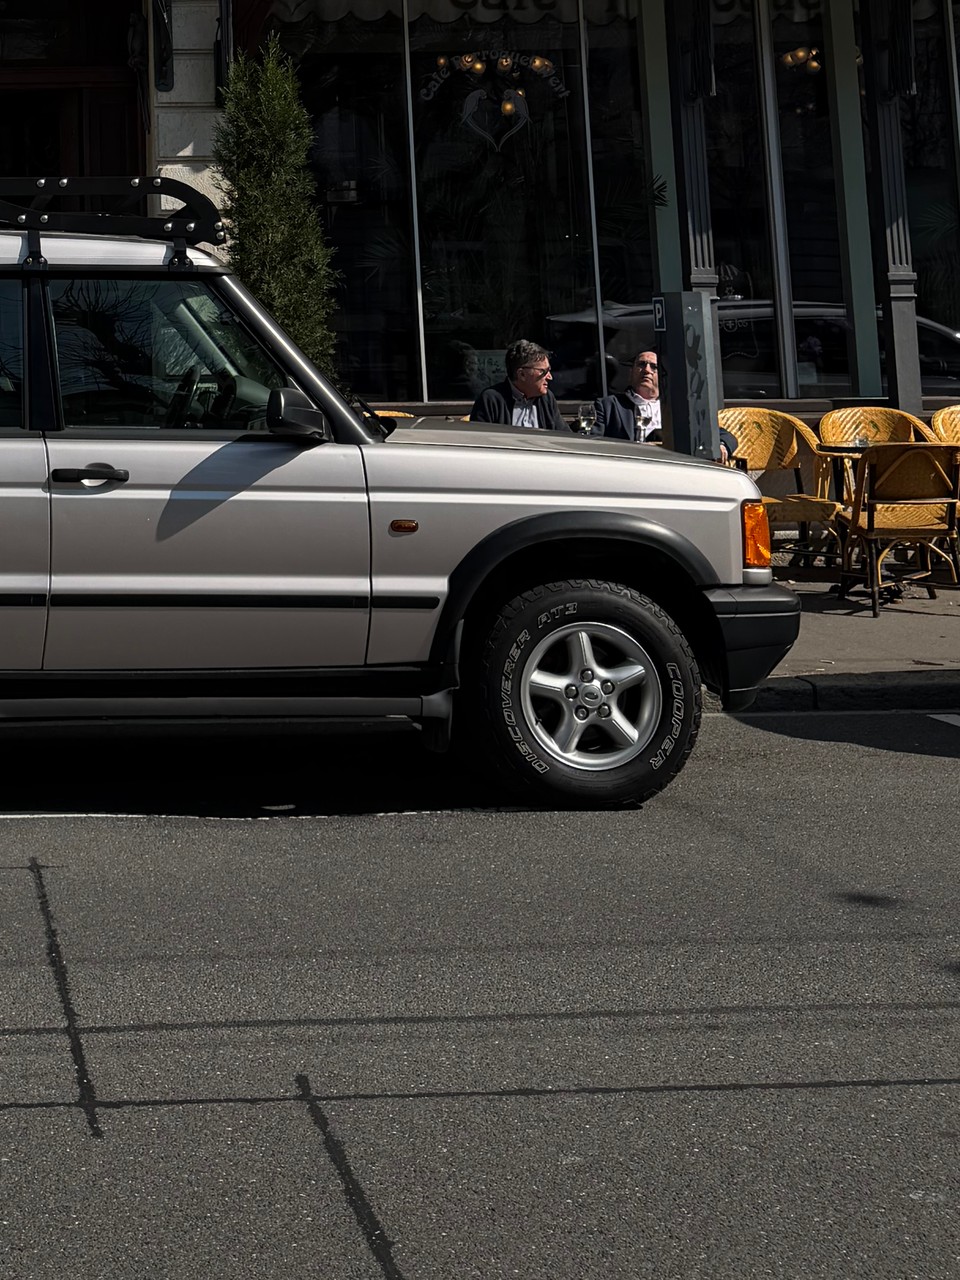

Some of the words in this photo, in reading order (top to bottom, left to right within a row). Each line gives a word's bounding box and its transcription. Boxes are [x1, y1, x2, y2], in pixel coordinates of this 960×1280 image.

[655, 303, 662, 327] P
[500, 629, 550, 775] DISCOVERER
[537, 601, 579, 629] AT3
[649, 662, 686, 771] COOPER
